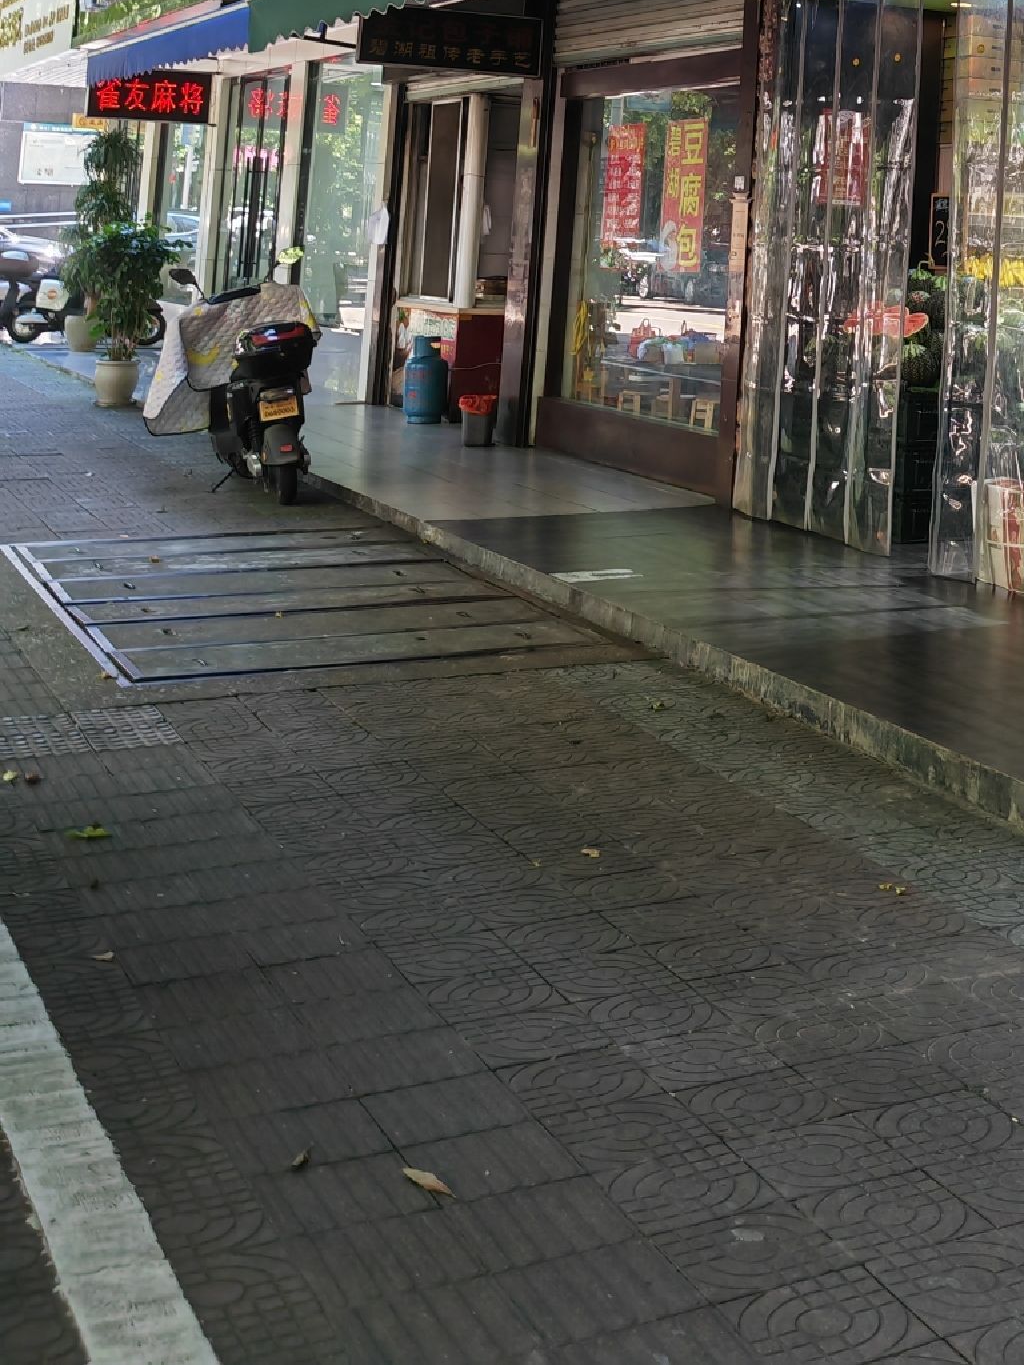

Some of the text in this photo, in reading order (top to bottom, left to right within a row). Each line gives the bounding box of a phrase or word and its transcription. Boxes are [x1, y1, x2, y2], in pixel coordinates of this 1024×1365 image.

[96, 78, 204, 114] 雀友麻将
[678, 123, 705, 268] 豆腐包
